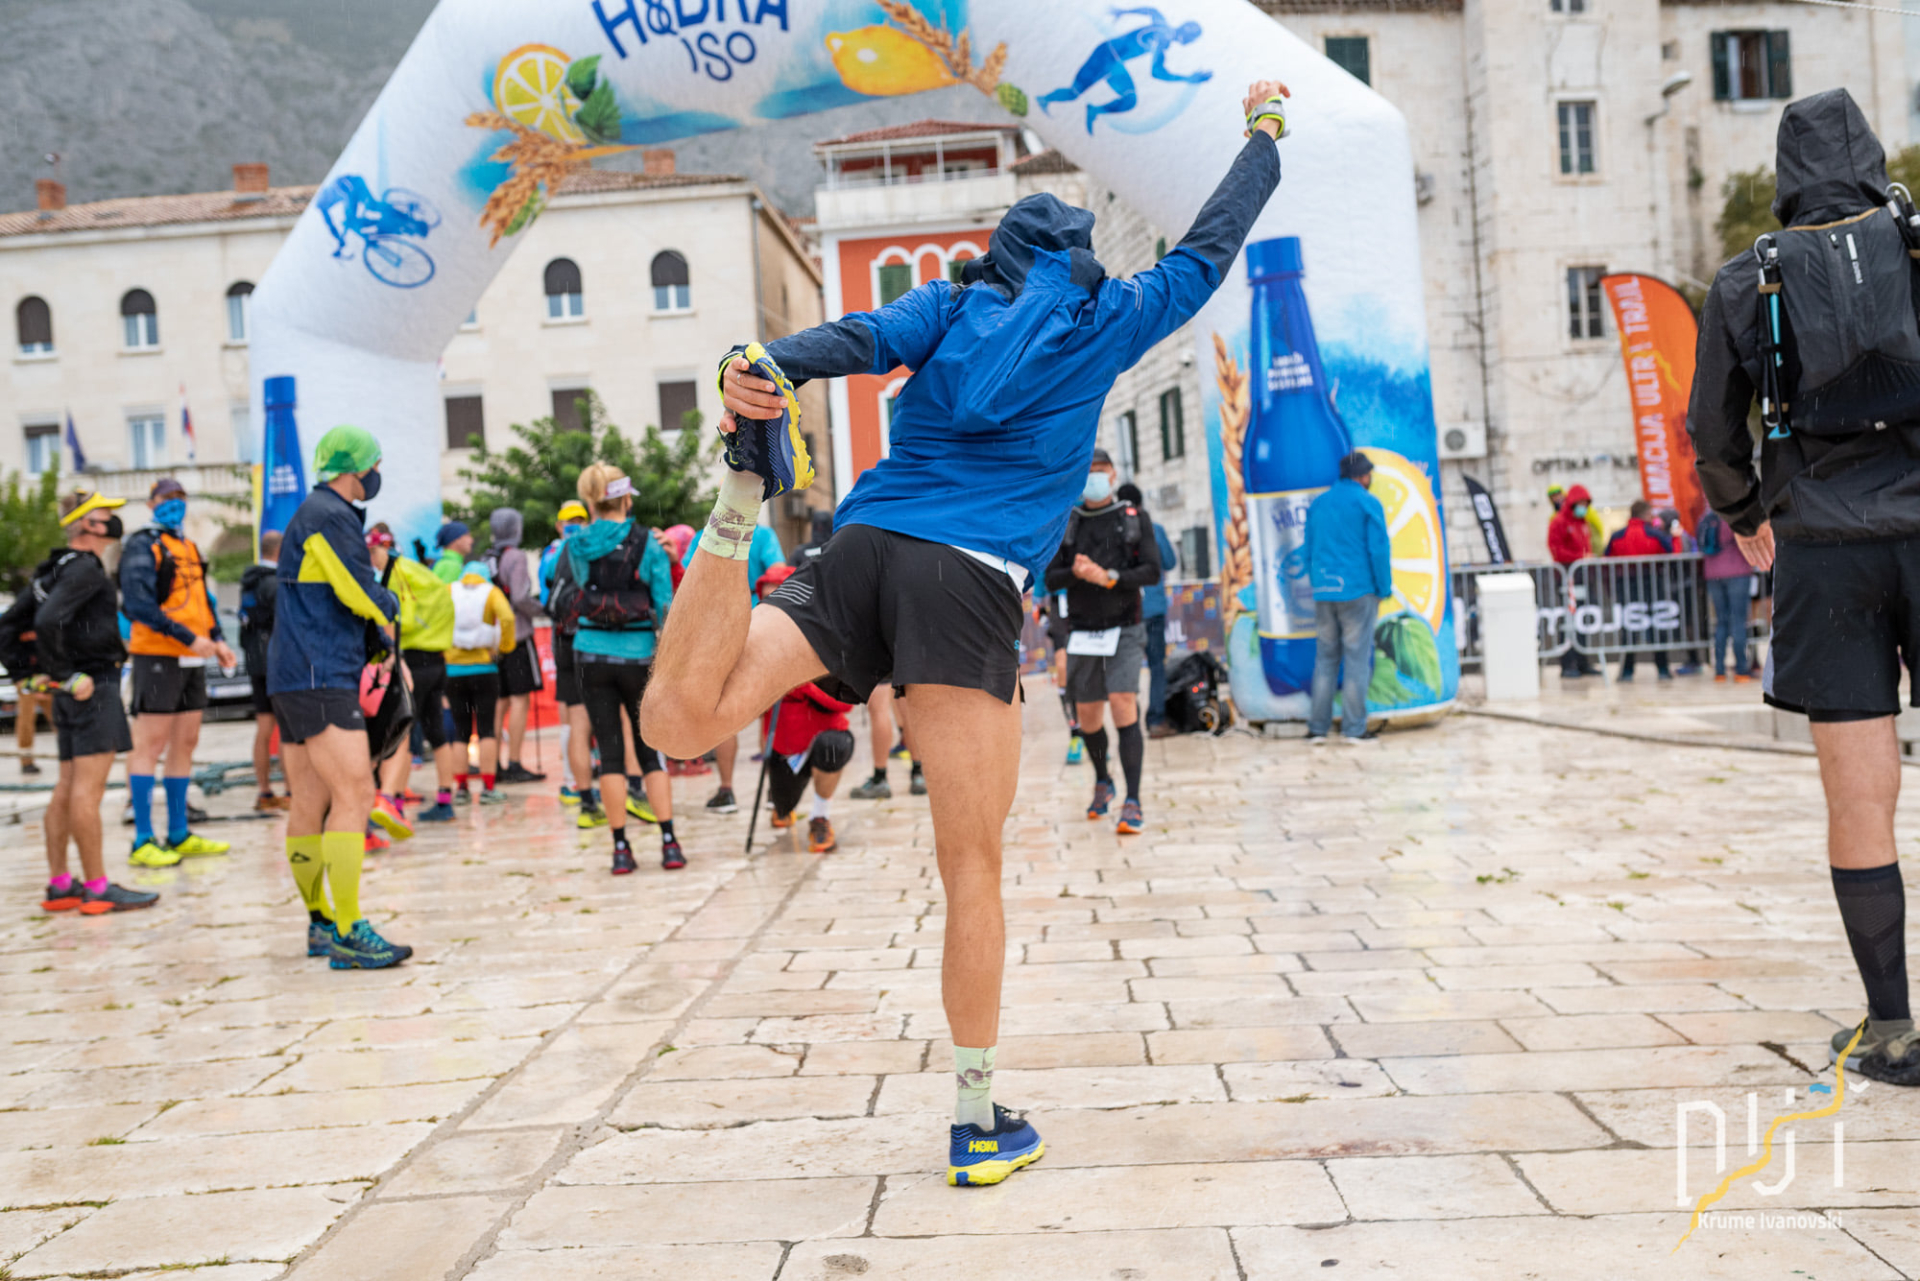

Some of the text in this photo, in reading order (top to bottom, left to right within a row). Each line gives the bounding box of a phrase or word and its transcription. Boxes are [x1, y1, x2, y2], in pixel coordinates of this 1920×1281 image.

[680, 31, 757, 81] ISO
[1613, 275, 1650, 337] TRAIL
[1640, 412, 1676, 516] LMACIJA
[968, 1140, 999, 1153] HOKA
